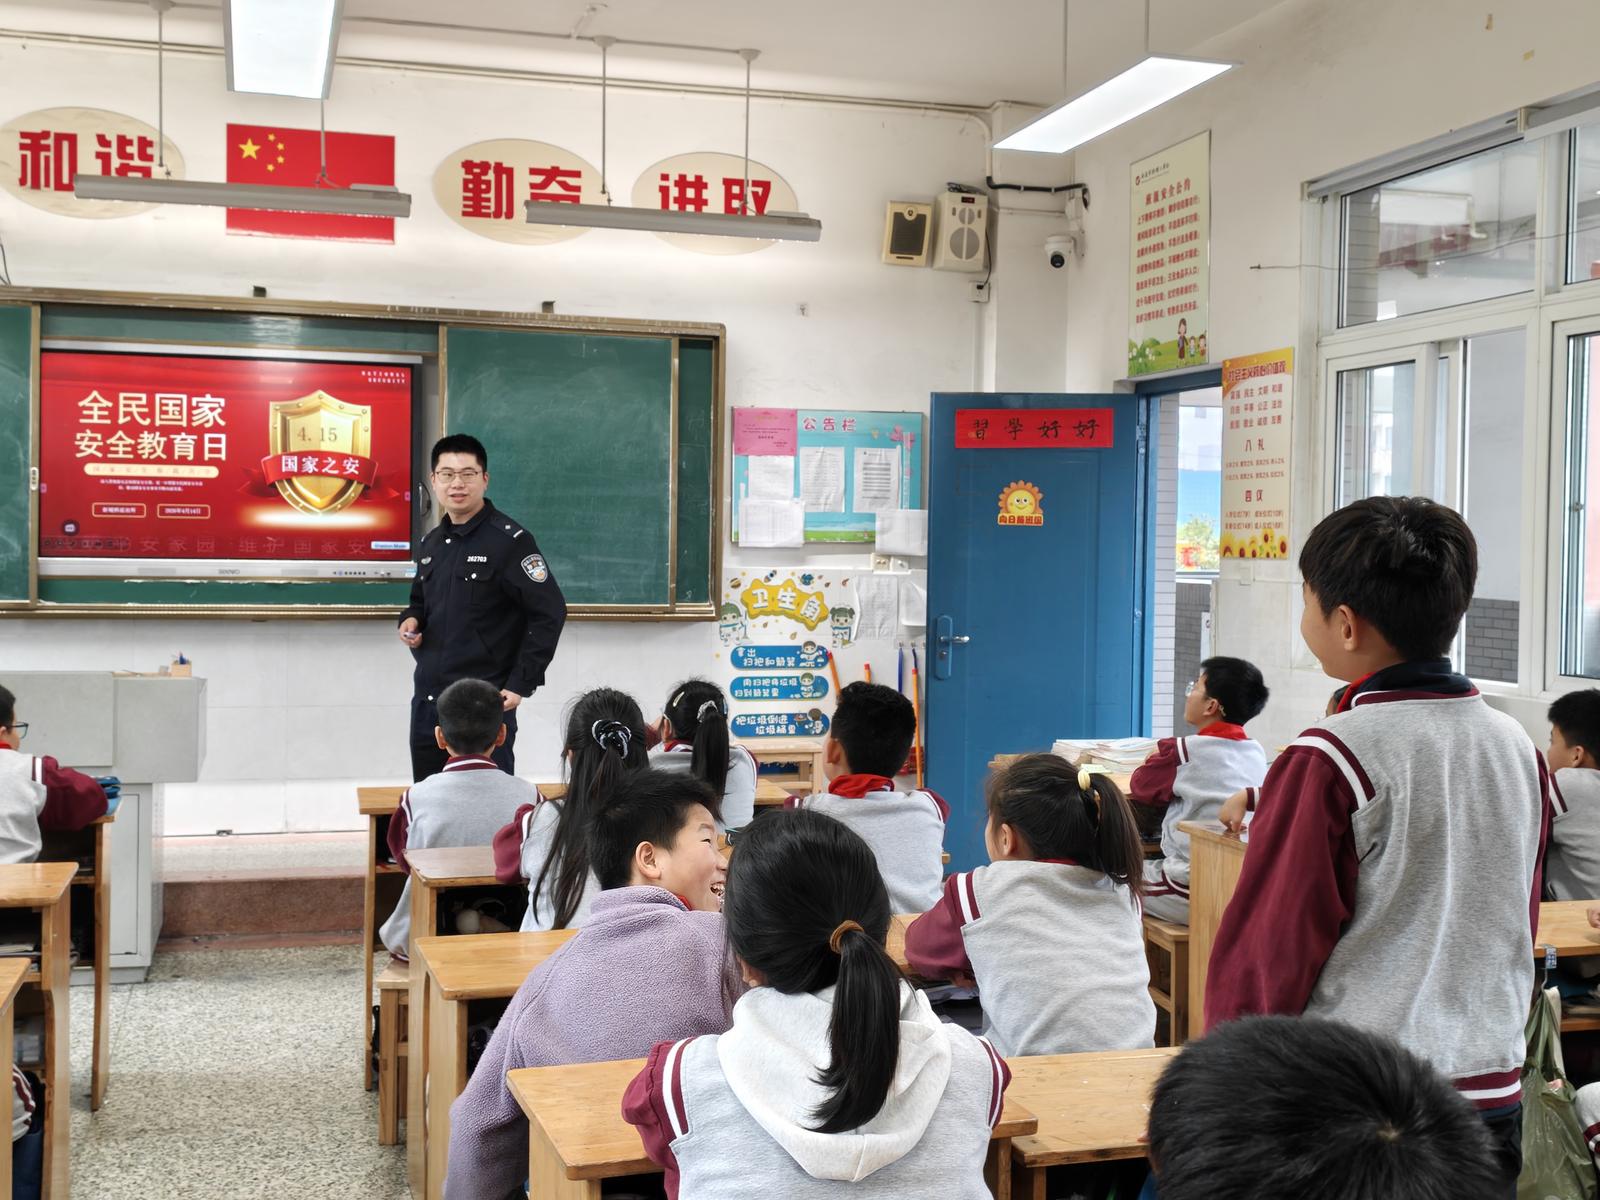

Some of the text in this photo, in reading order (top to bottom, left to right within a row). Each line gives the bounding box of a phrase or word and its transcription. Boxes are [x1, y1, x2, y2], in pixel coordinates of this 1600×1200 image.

[19, 130, 154, 191] 和谐
[77, 390, 227, 428] 全民国家
[803, 417, 856, 431] 公告栏
[74, 428, 227, 462] 安全教育日
[281, 455, 360, 475] 国家之安
[752, 588, 821, 623] 卫生角
